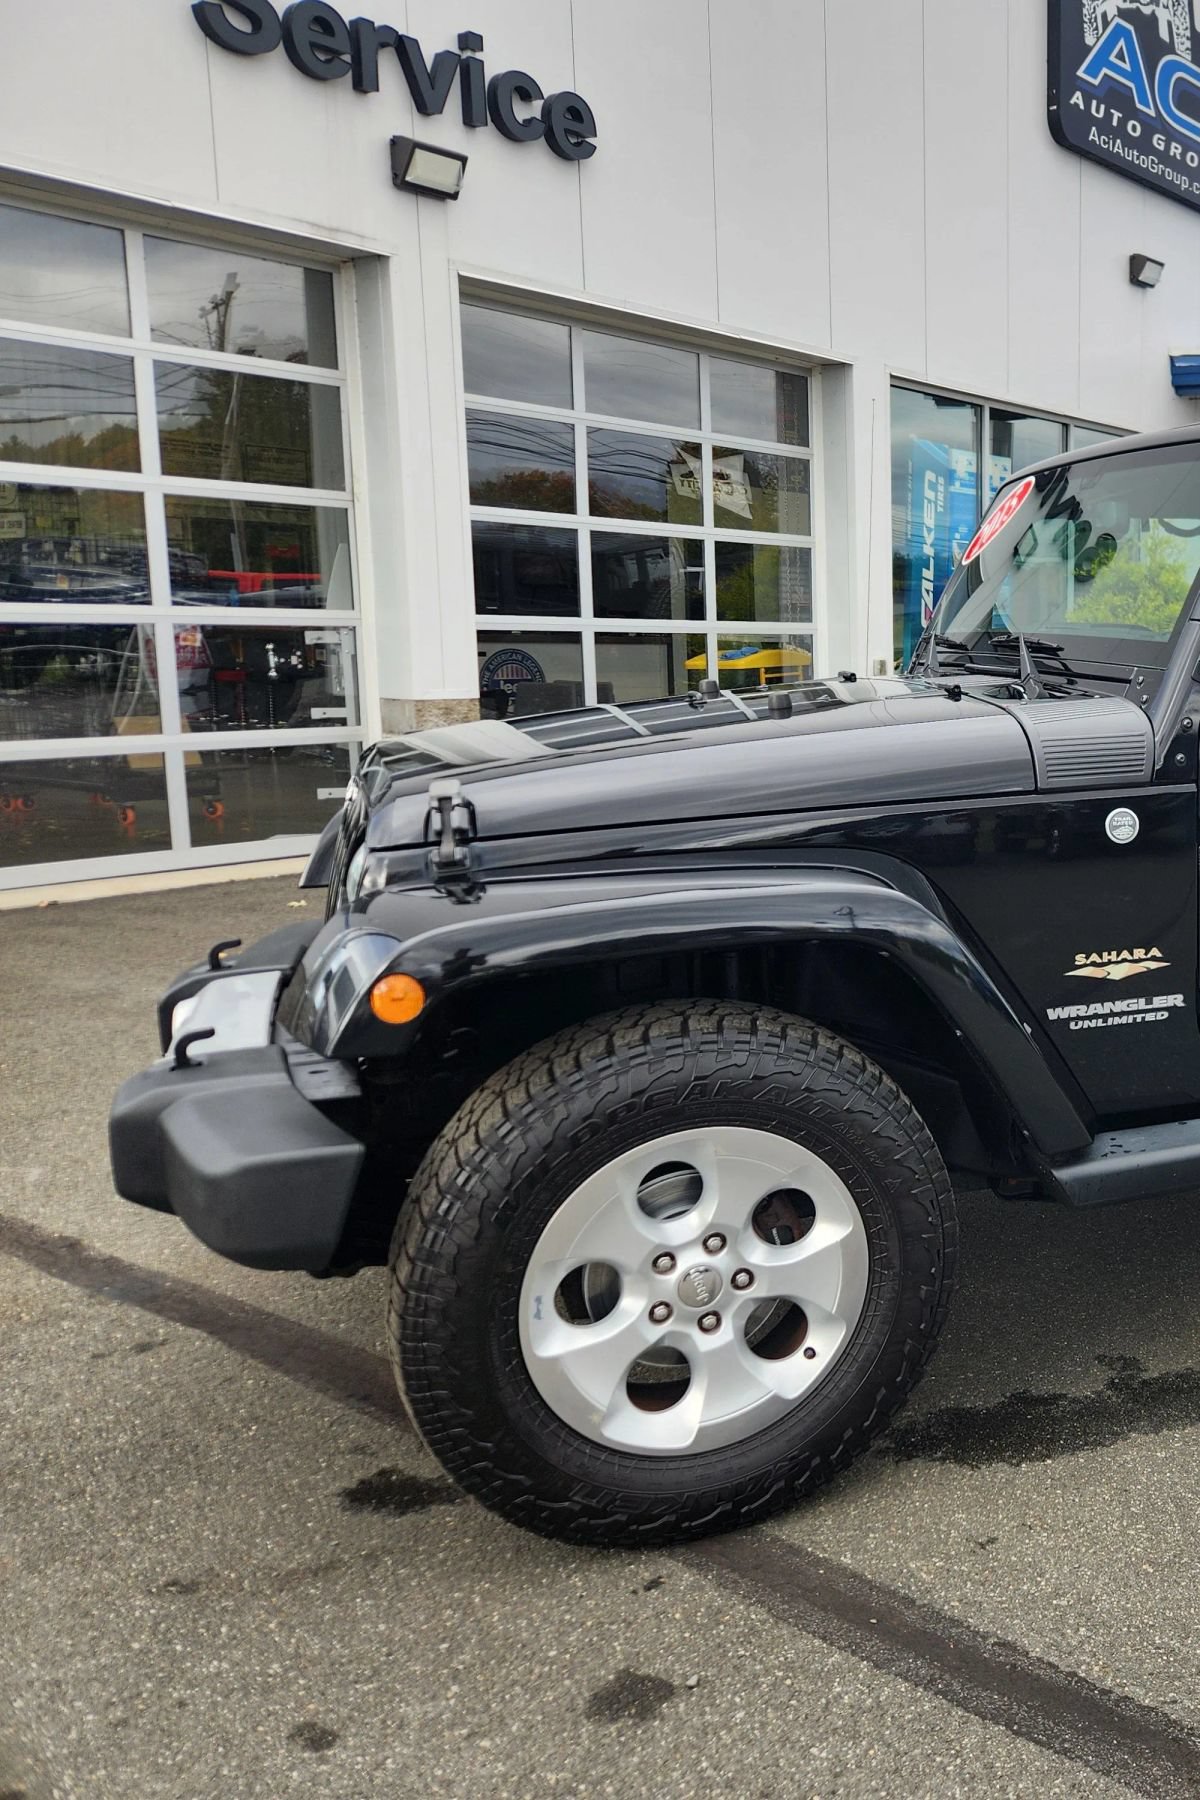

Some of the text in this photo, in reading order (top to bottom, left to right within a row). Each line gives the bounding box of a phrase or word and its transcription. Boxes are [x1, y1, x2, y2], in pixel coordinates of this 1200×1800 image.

[1069, 91, 1142, 137] AUTO
[937, 476, 945, 513] TIRES
[920, 470, 938, 629] FALKEN
[1074, 947, 1164, 966] SAHARA
[1046, 993, 1186, 1021] WRANGLER
[1069, 1011, 1169, 1030] UNLIMITED
